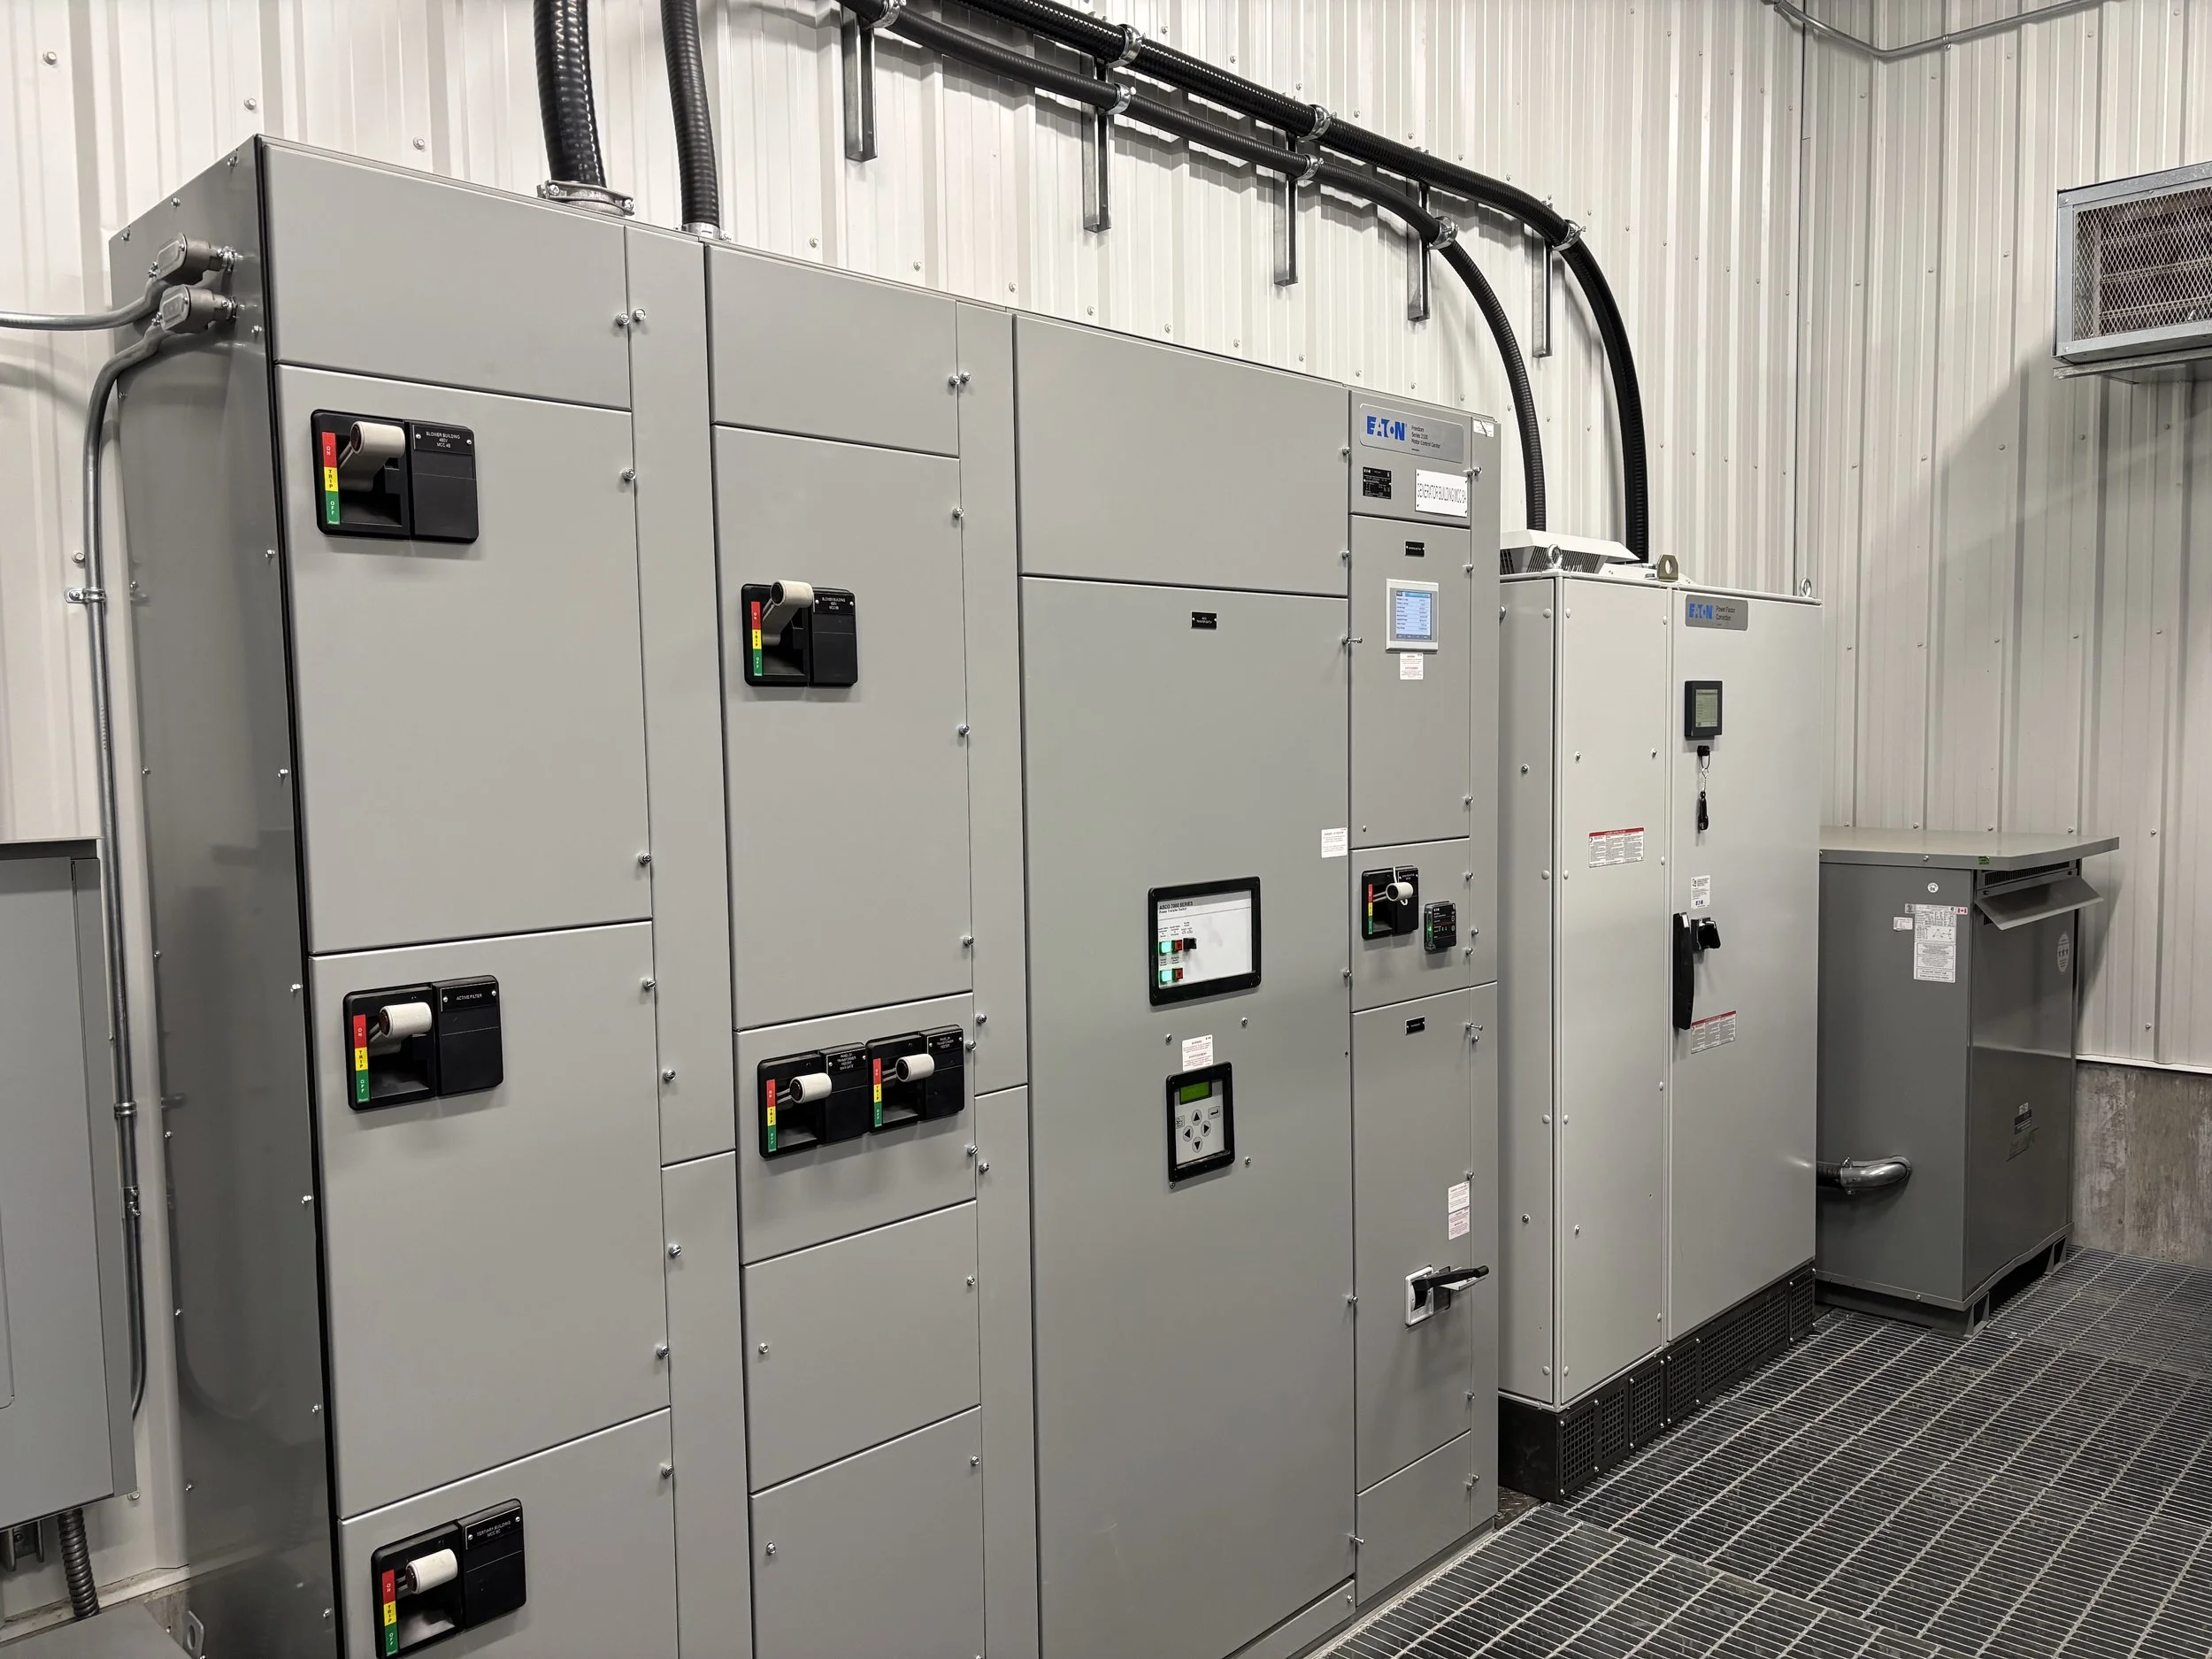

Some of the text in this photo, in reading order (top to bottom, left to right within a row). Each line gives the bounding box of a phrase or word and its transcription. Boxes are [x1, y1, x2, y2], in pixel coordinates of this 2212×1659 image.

[1366, 415, 1406, 441] EATON
[326, 446, 331, 456] ON
[357, 1027, 363, 1037] ON
